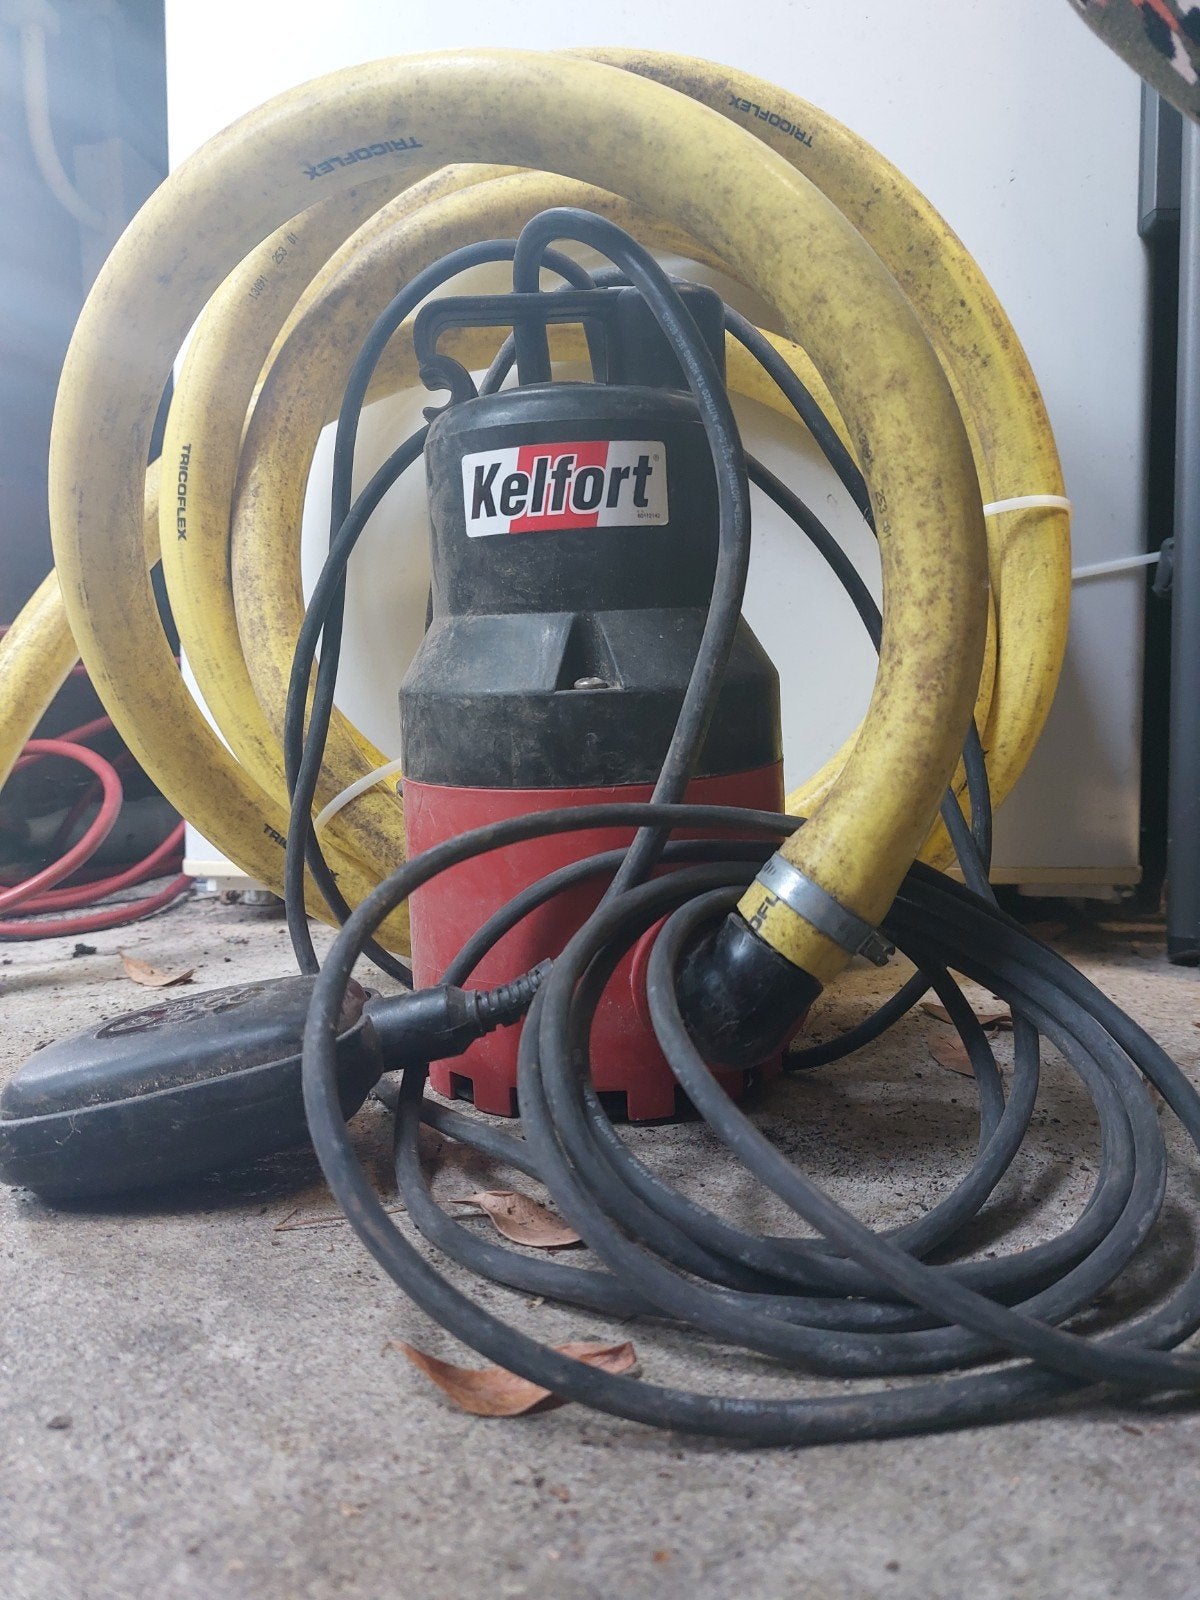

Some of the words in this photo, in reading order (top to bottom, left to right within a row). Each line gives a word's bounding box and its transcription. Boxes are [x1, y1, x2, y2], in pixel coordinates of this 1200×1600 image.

[728, 95, 814, 148] TRICOFLEX
[303, 137, 423, 180] TRICOFLEX
[272, 247, 287, 264] 253
[177, 443, 192, 541] TRICOFLEX
[471, 455, 653, 520] Kelfort
